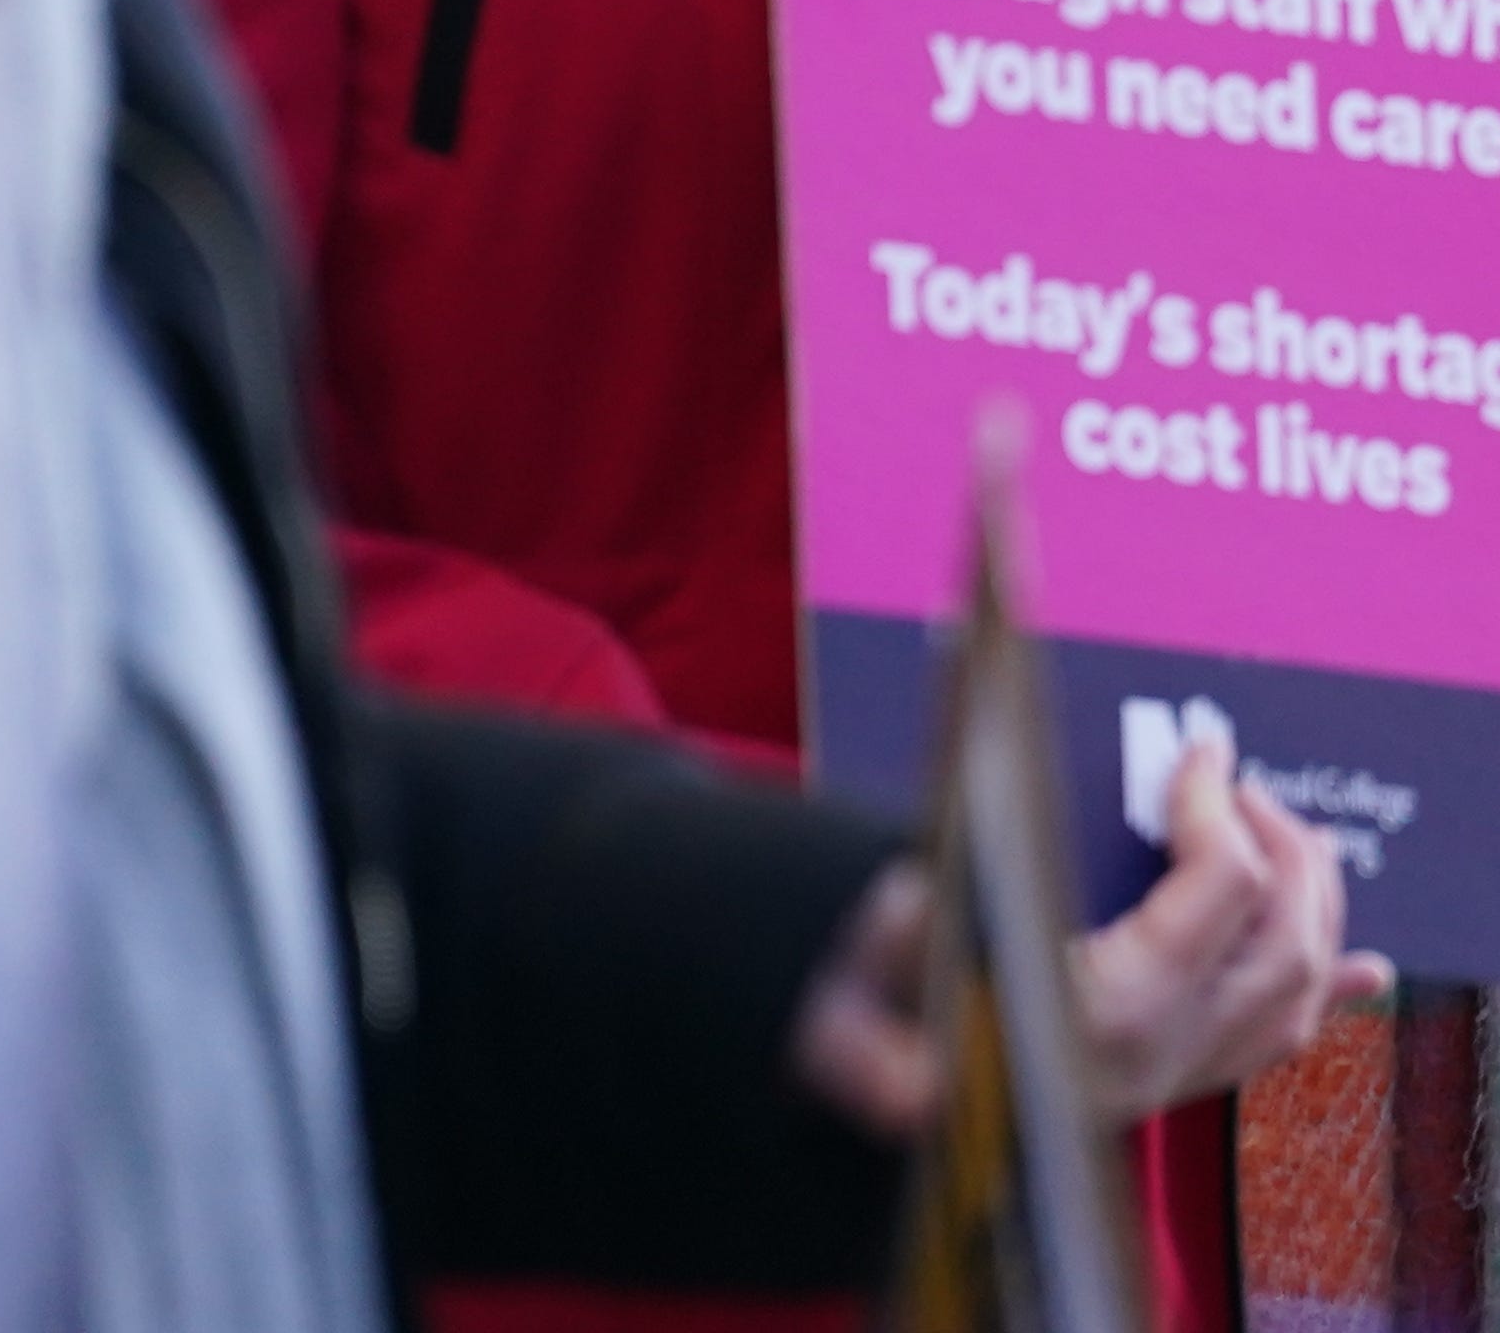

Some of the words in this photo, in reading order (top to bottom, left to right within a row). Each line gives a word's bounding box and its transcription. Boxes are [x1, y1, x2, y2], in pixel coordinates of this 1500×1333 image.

[929, 33, 1093, 127] you
[1106, 56, 1318, 152] need
[870, 241, 1200, 377] Today’s
[1062, 399, 1247, 490] cost
[1256, 402, 1451, 516] lives
